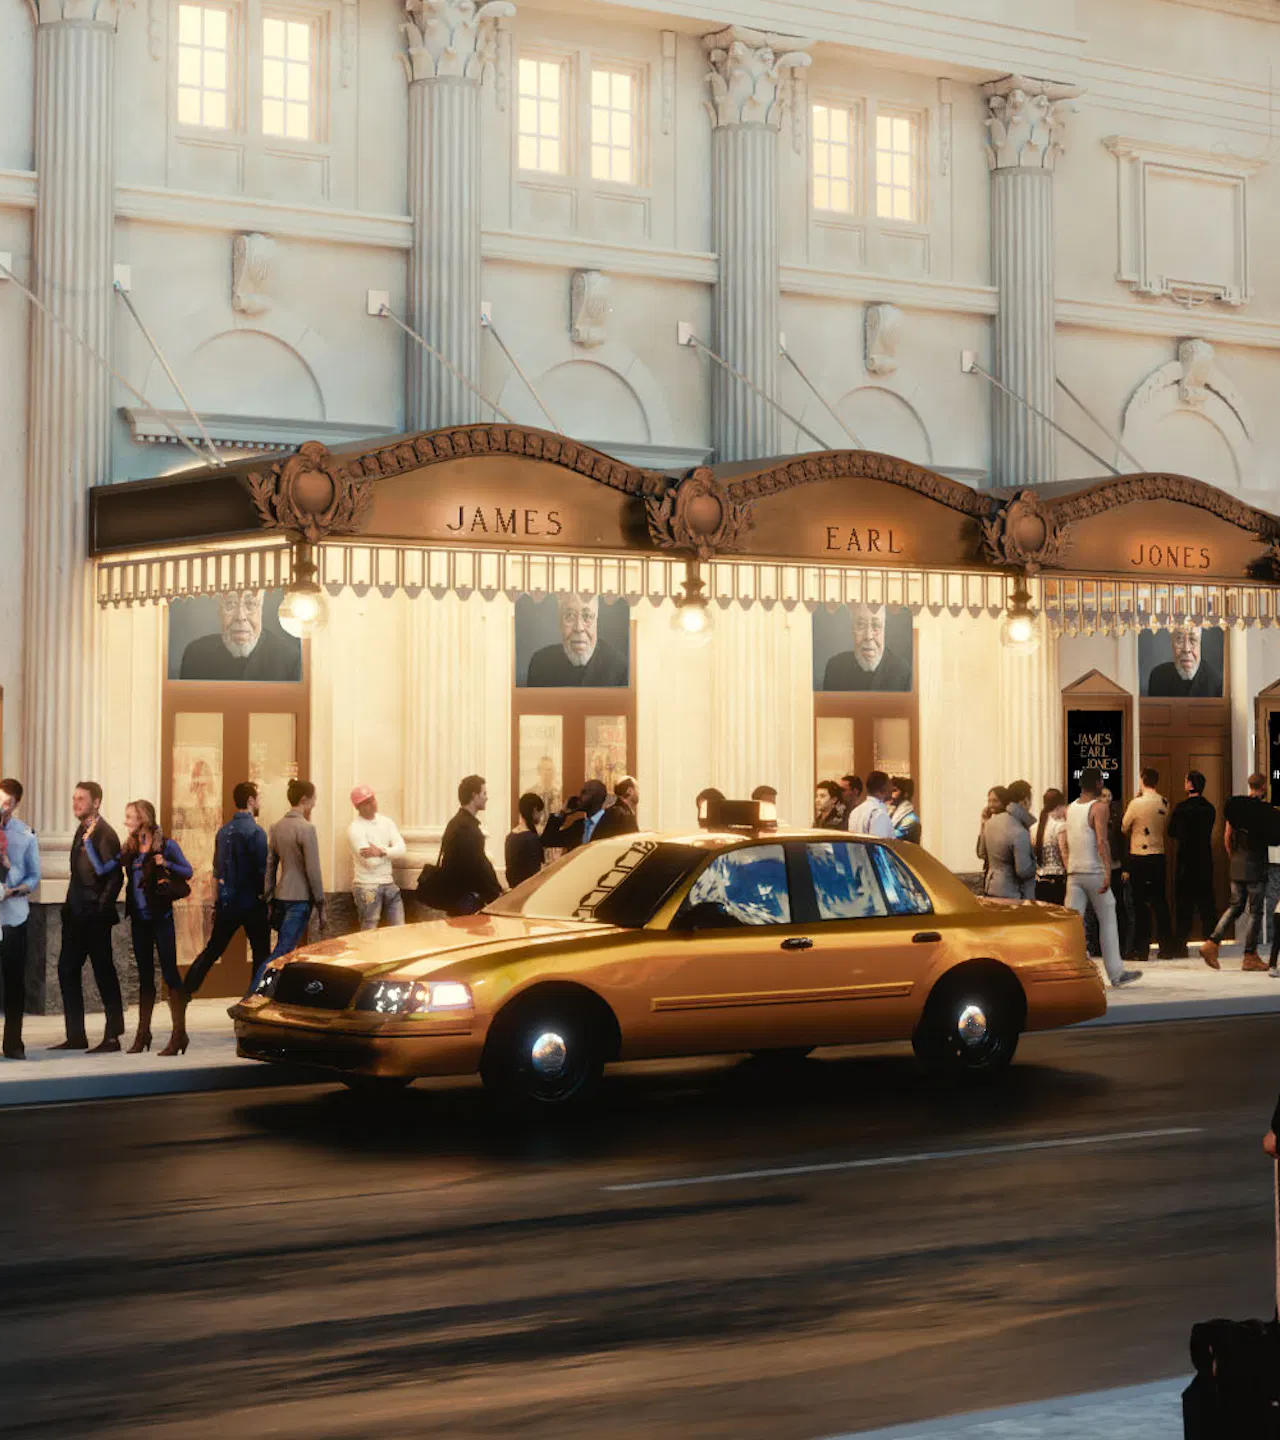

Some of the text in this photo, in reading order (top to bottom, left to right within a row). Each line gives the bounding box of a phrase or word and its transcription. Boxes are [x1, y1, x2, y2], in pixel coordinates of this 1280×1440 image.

[446, 506, 1211, 569] JAMES EARL JONES
[1073, 733, 1112, 746] JAMES
[1080, 746, 1109, 758] EARL
[1082, 758, 1119, 770] JONES
